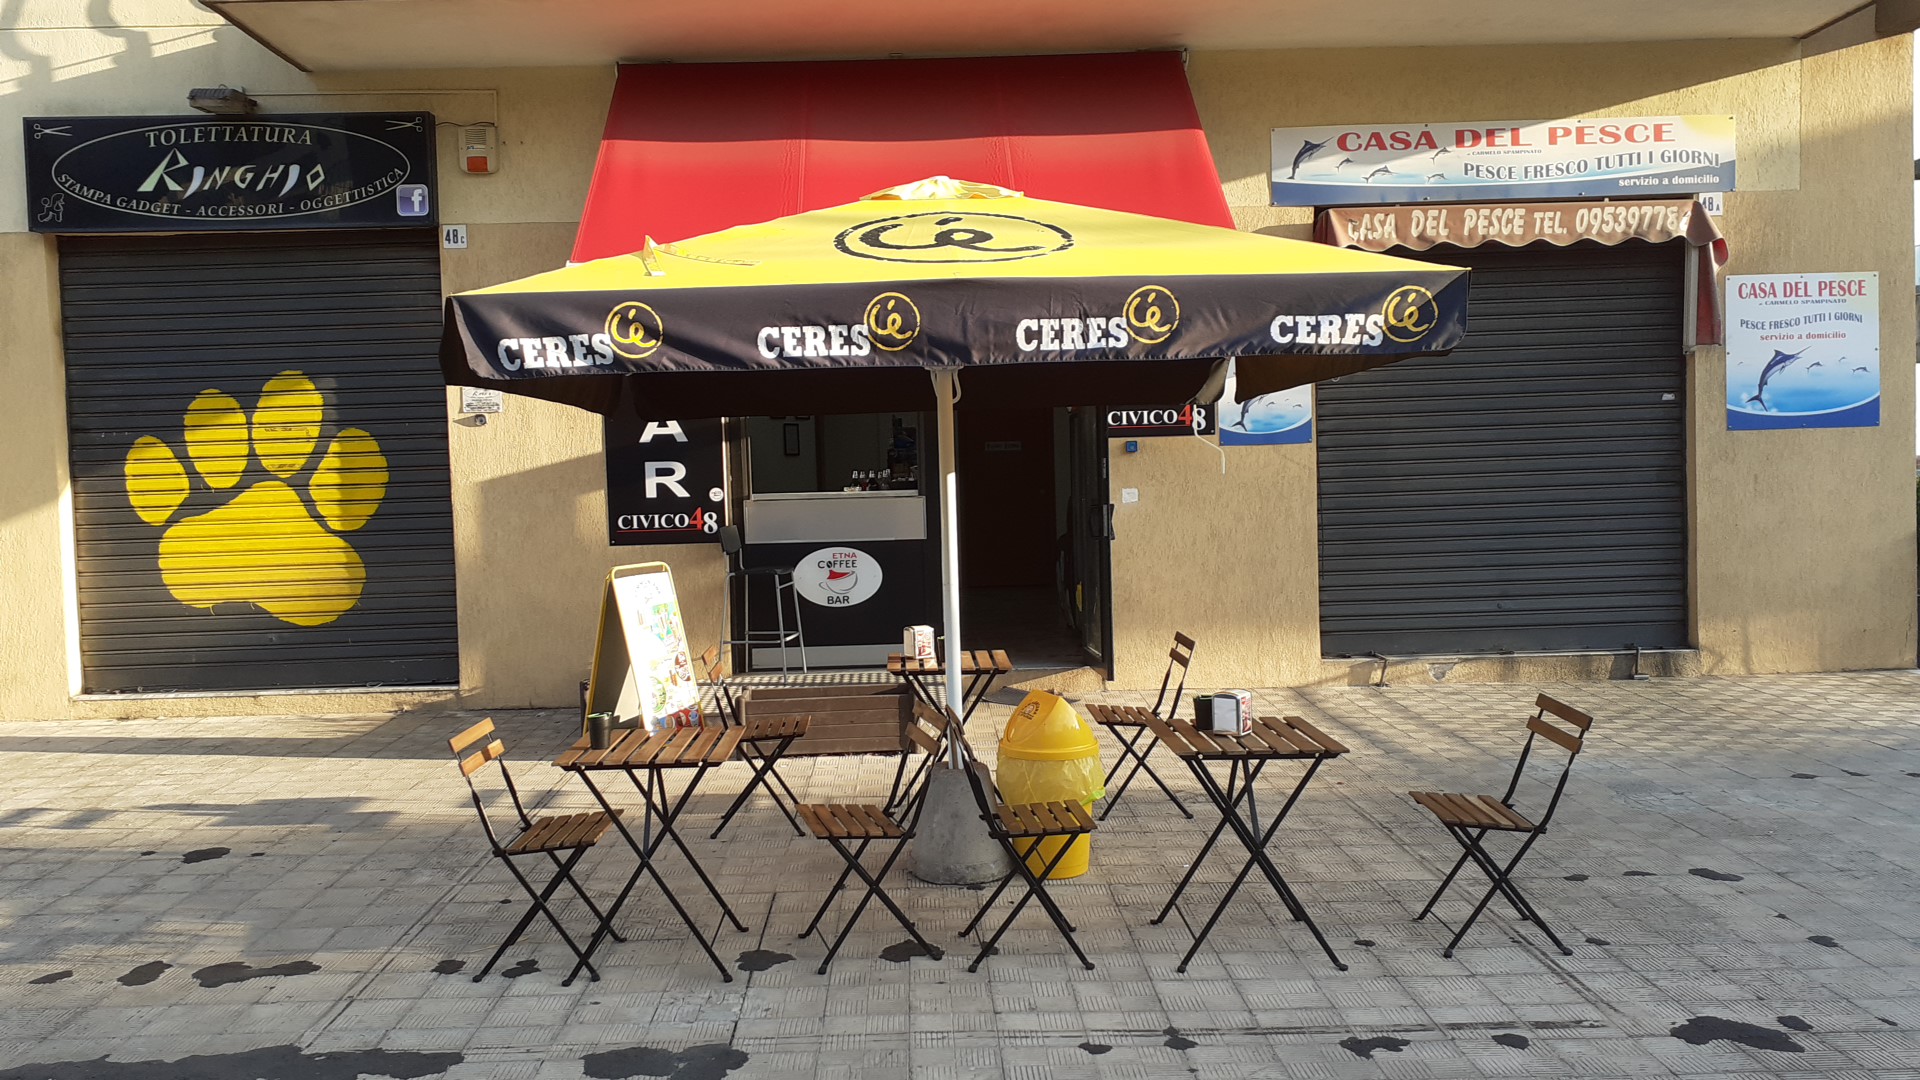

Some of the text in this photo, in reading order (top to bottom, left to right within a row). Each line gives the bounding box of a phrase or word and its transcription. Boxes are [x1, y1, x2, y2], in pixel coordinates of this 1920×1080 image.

[145, 126, 312, 148] TOLETTATURA
[1337, 123, 1676, 152] CASA DEL PESCE
[1464, 149, 1720, 180] PESCE FRESCO TUTTI I GIORNI
[58, 167, 404, 217] STAMPA GADGET ACCESSORI OGGETTISTICA
[1618, 175, 1720, 187] servizio a domicilio
[1348, 213, 1397, 241] CASA
[1411, 209, 1449, 238] DEL
[1463, 208, 1526, 236] PESCE
[1534, 211, 1567, 235] TEL.
[1738, 279, 1867, 299] CASA DEL PESCE
[1016, 316, 1129, 351] CERES
[1270, 313, 1385, 346] CERES
[1740, 318, 1766, 331] PESCE
[1769, 316, 1800, 330] FRESCO
[1803, 312, 1826, 325] TUTTI
[1834, 311, 1863, 324] GIORNI
[757, 324, 871, 359] CERES
[1760, 332, 1795, 341] servizio
[1805, 330, 1846, 340] domicilio
[498, 333, 614, 371] CERES
[1107, 404, 1206, 431] CIVICO48
[617, 507, 718, 534] CIVICO48
[817, 560, 858, 569] COFFEE
[827, 595, 850, 604] BAR
